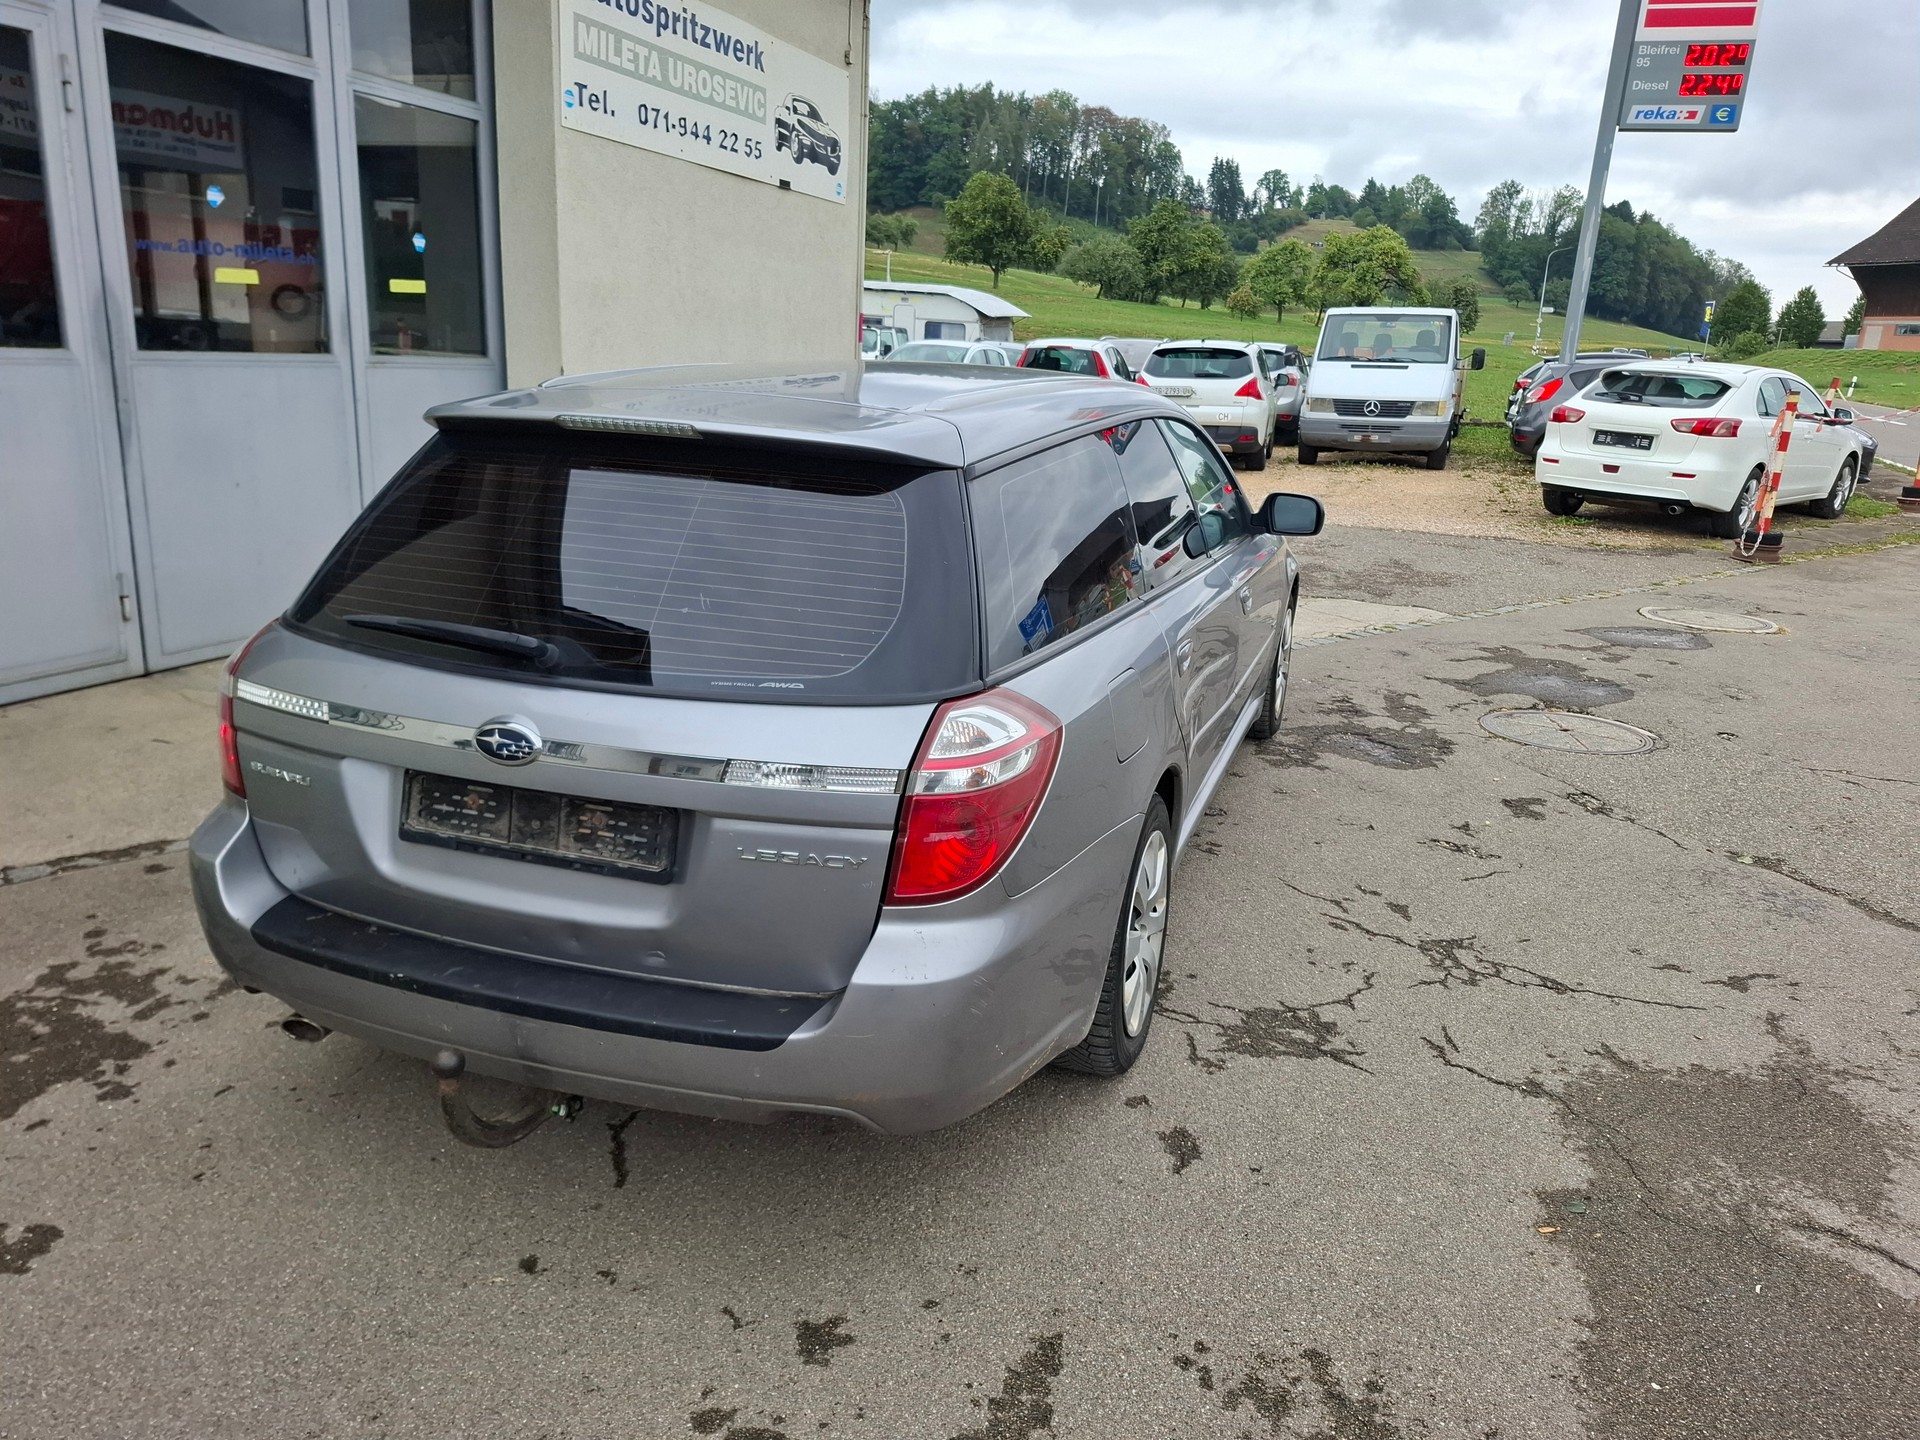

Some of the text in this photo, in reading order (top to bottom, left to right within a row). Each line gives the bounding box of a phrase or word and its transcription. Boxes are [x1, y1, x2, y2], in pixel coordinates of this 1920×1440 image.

[1638, 44, 1681, 55] Bleifrei
[1636, 57, 1651, 67] 95
[577, 21, 766, 118] MILETA UROSEVIC
[1632, 80, 1669, 90] Diesel
[574, 82, 763, 160] Tel. 071-944 22 55
[1218, 413, 1229, 421] CH
[737, 847, 868, 870] LEGACY
